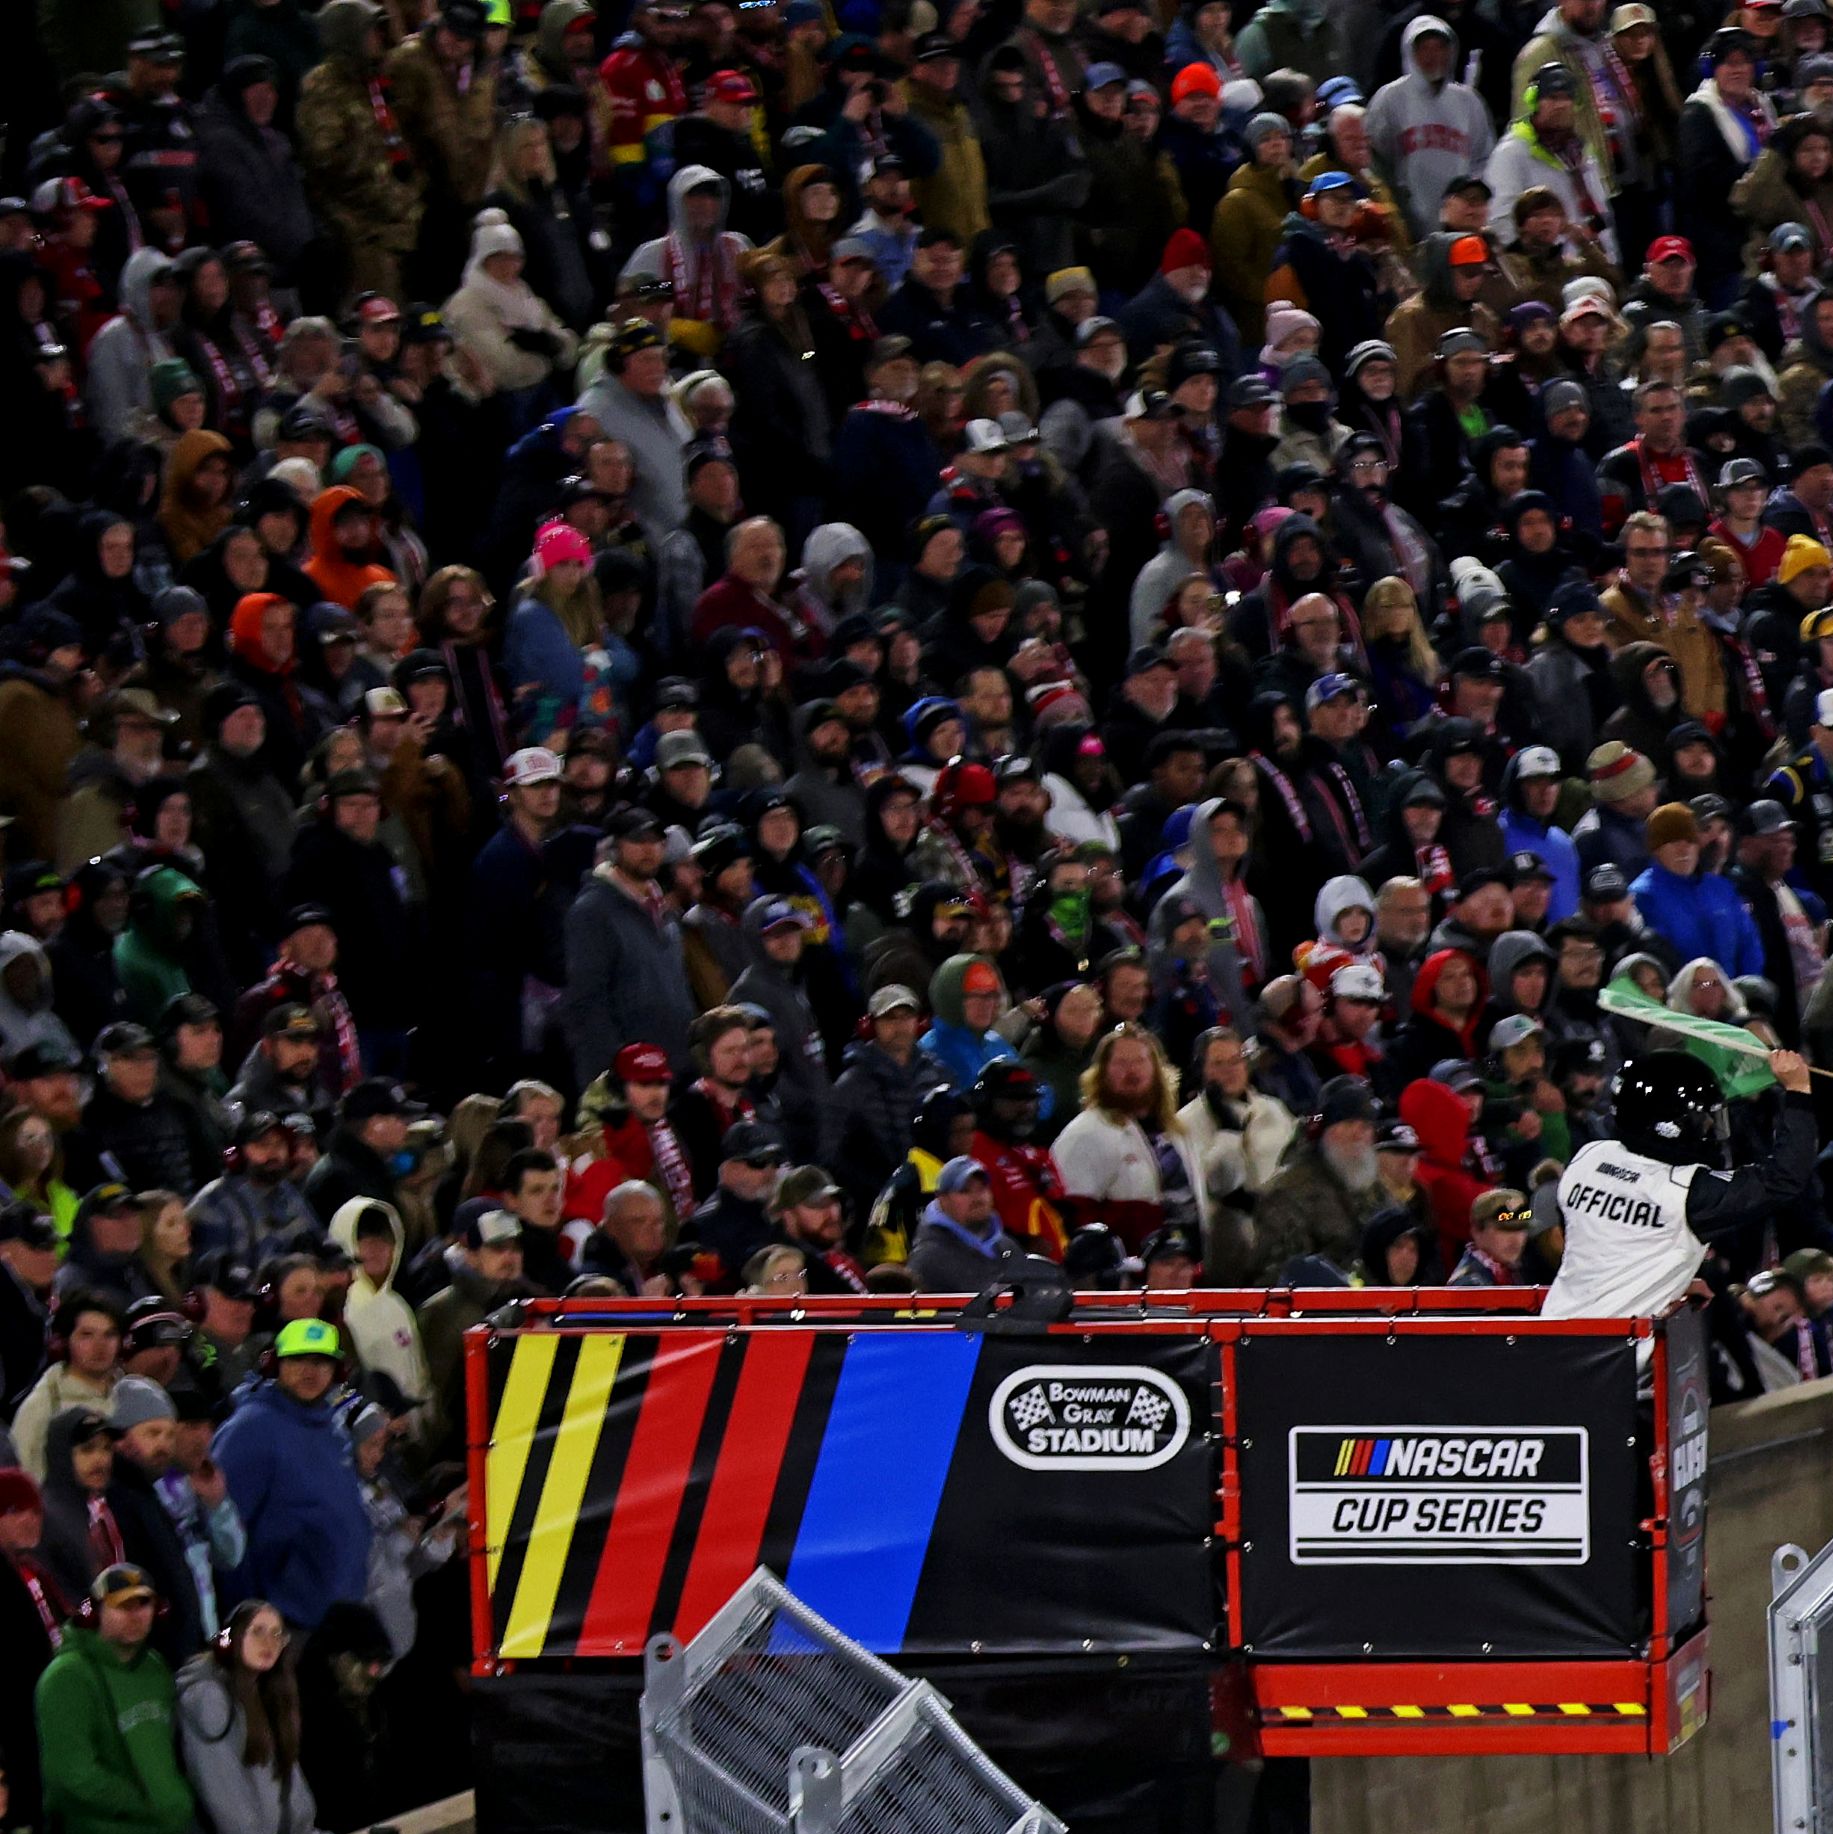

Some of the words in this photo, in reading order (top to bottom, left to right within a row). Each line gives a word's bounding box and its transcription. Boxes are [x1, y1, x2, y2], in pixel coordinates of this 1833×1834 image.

[1566, 1182, 1666, 1229] OFFICIAL
[1027, 1427, 1156, 1453] STADIUM
[1383, 1438, 1545, 1478] NASCAR
[1332, 1498, 1408, 1533] CUP
[1415, 1498, 1547, 1534] SERIES
